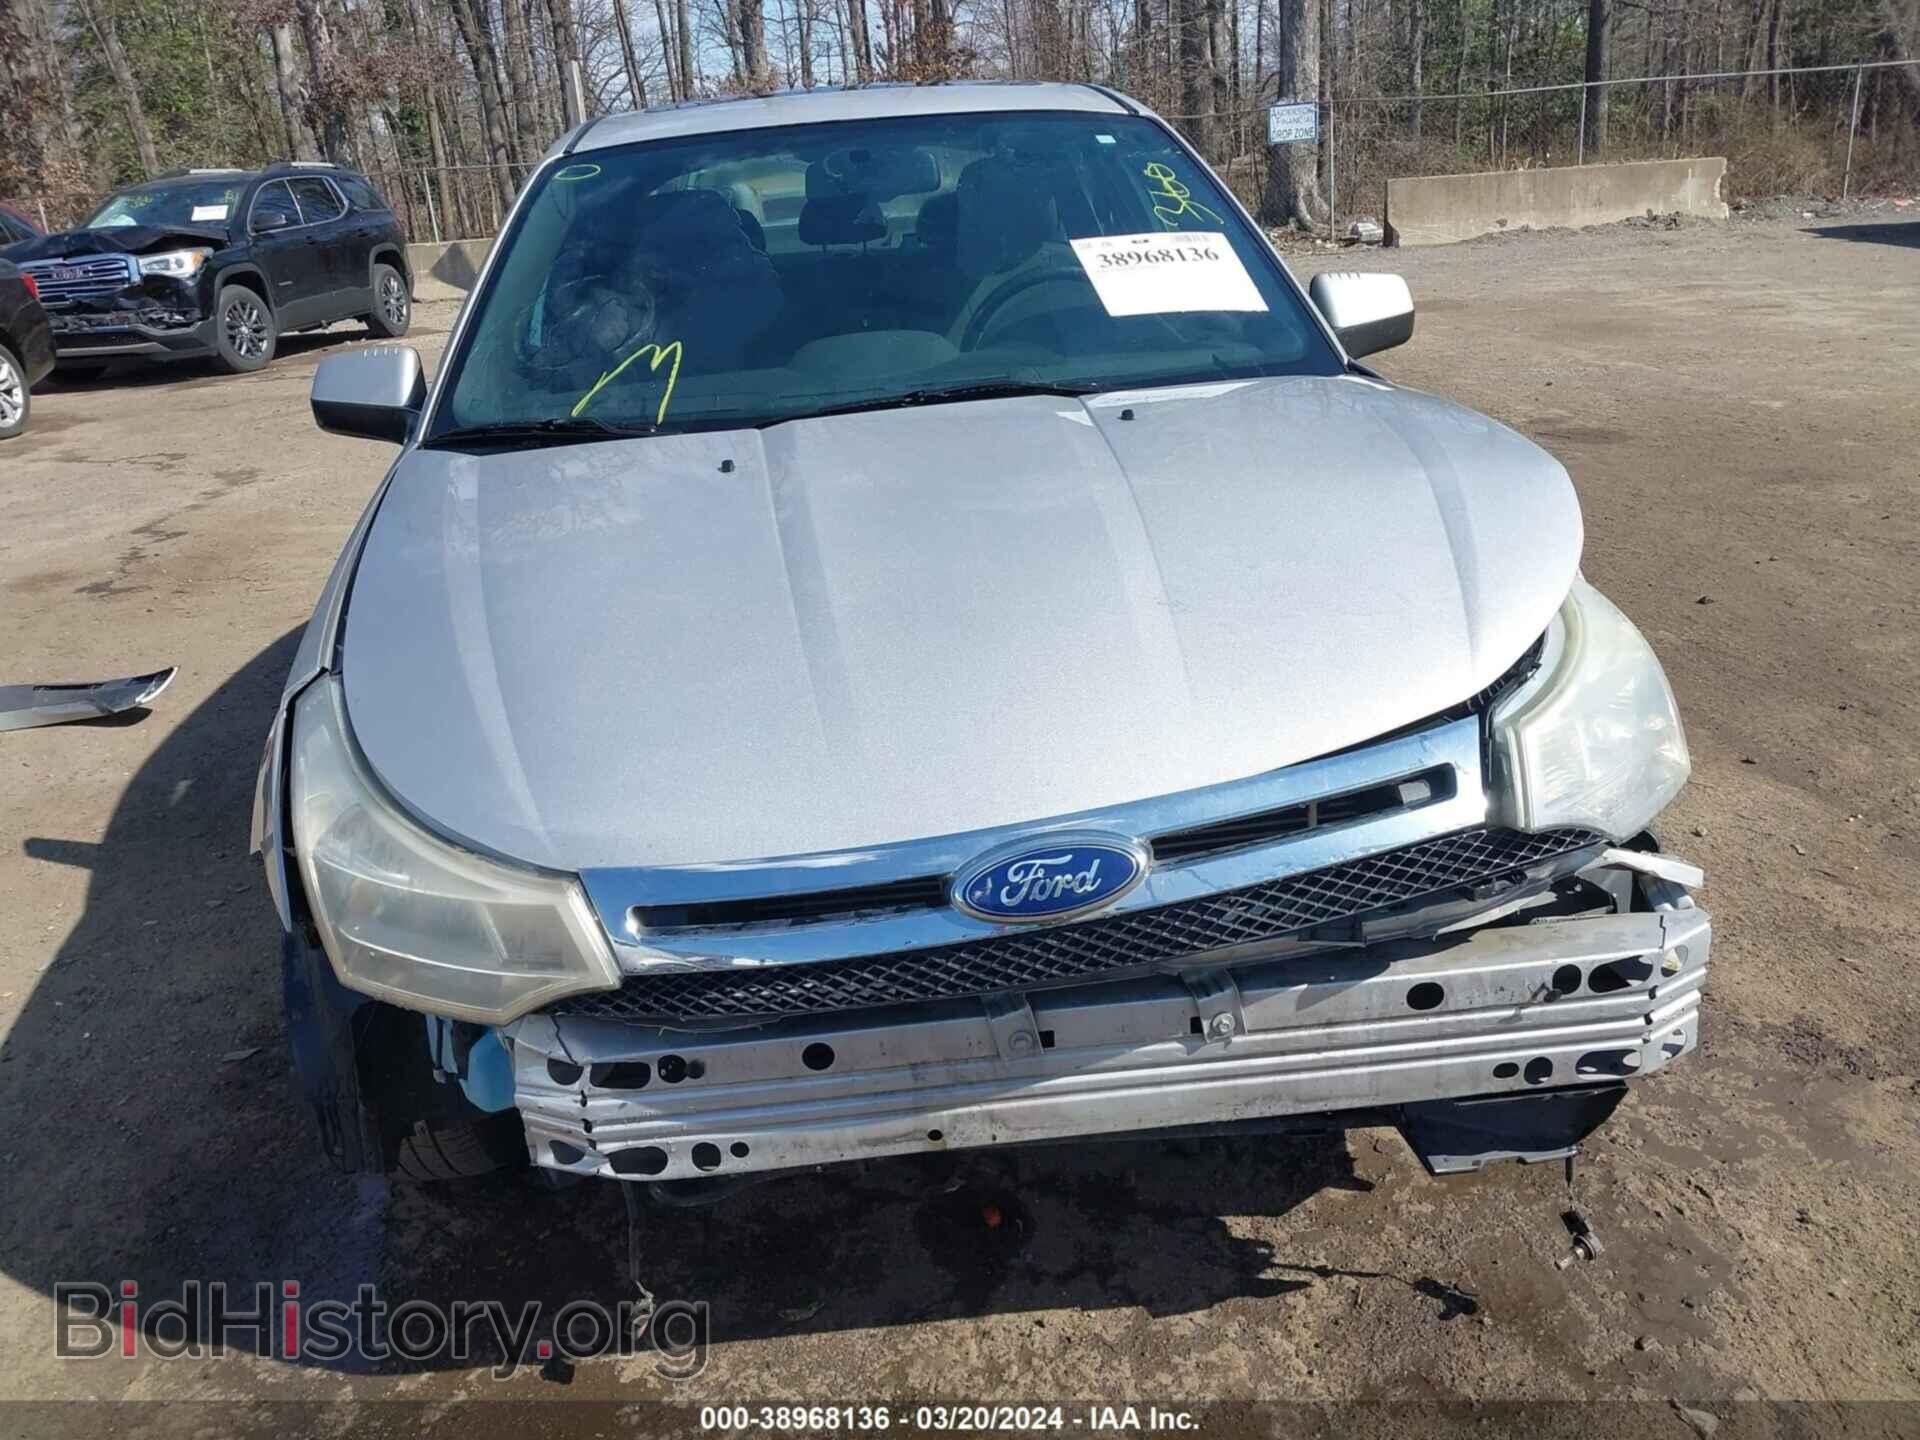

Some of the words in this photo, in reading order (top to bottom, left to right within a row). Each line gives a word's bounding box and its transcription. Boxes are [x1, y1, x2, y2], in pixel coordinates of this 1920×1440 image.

[1294, 126, 1313, 138] ZONE
[1096, 246, 1220, 268] 38968136
[1000, 854, 1102, 906] Ford
